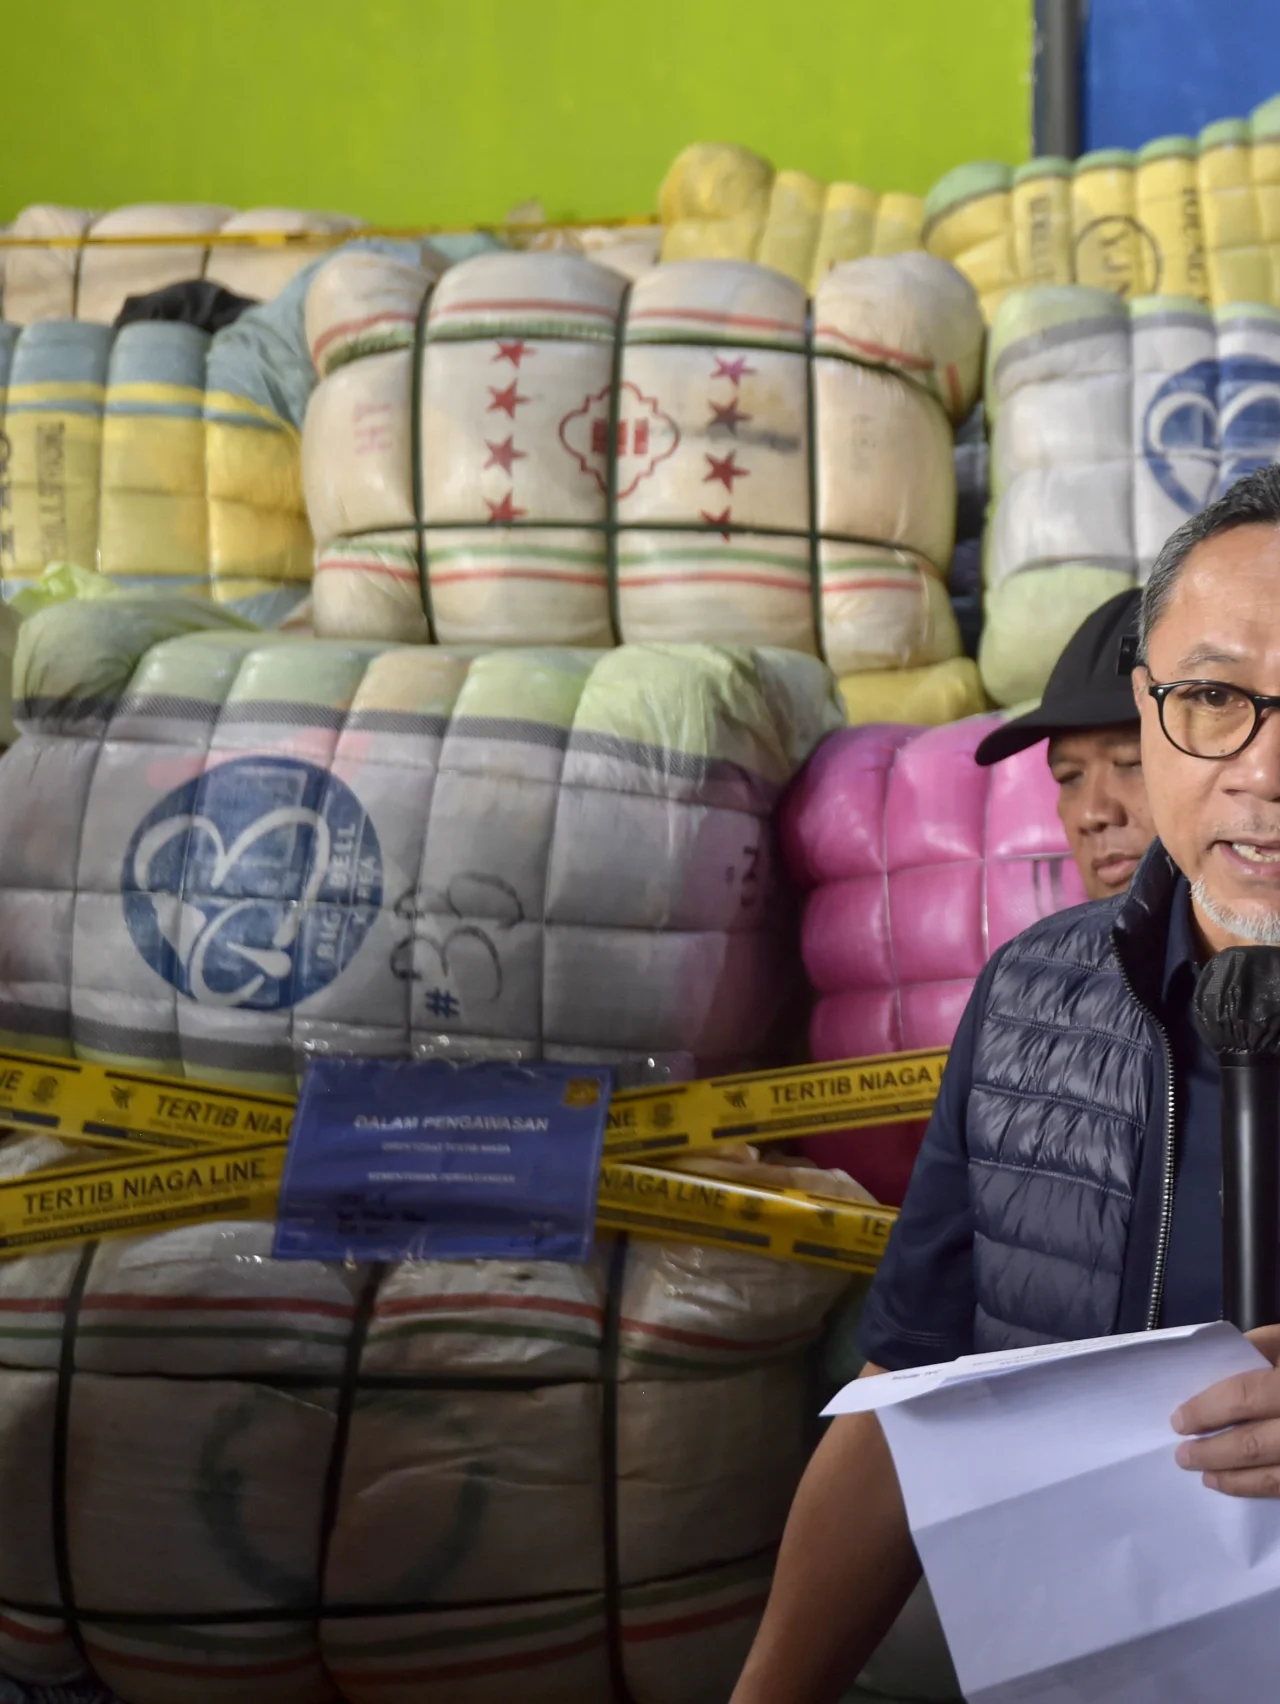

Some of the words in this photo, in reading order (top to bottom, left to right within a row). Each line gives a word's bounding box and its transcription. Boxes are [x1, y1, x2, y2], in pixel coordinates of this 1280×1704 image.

[328, 822, 357, 889] BELL
[316, 911, 342, 960] BIG
[769, 1076, 852, 1105] TERTIB
[859, 1065, 932, 1092] NIAGA
[156, 1095, 239, 1128] TERTIB
[244, 1110, 291, 1137] NIA
[354, 1114, 419, 1131] DALAM
[422, 1115, 549, 1132] PENGAWASAN
[606, 1106, 637, 1129] NE
[23, 1181, 114, 1214] TERTIB
[122, 1168, 202, 1199] NIAGA
[209, 1157, 267, 1185] LINE
[600, 1170, 670, 1200] NIAGA
[676, 1179, 728, 1209] LINE
